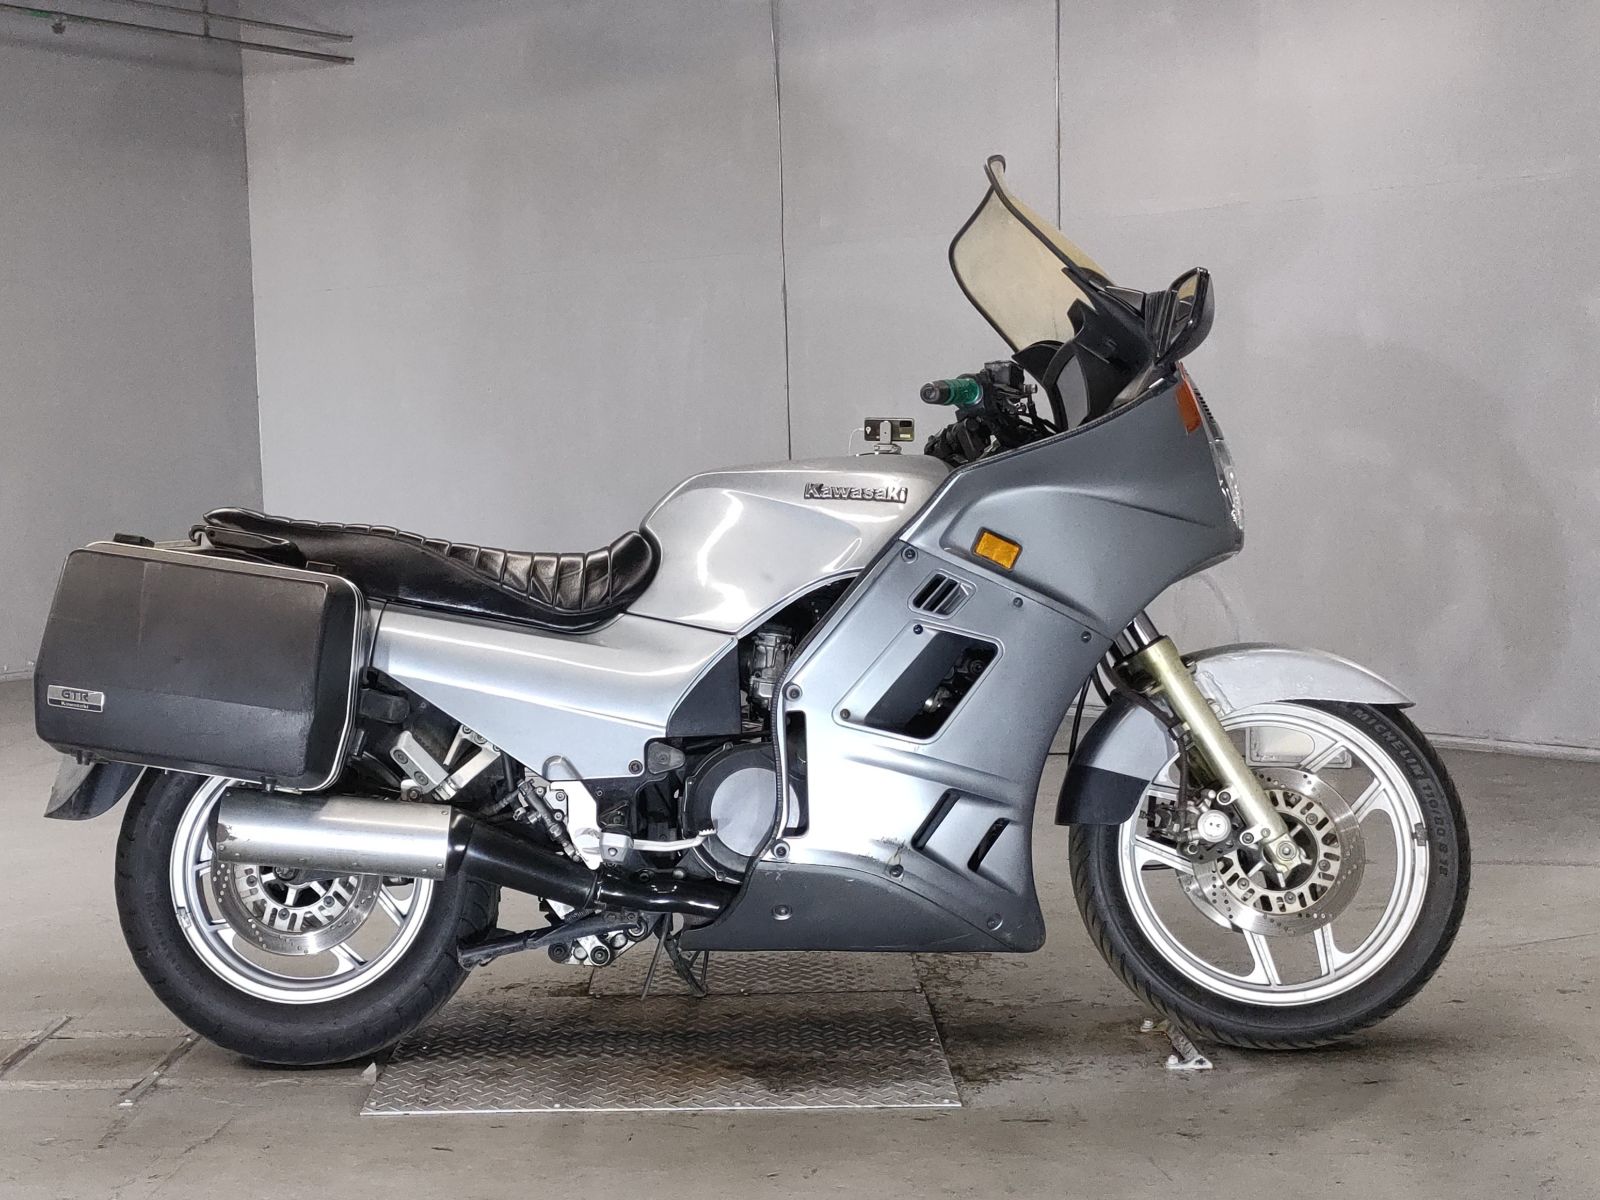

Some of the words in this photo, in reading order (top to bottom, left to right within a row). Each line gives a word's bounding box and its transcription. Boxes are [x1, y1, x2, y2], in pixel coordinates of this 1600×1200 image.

[803, 483, 908, 504] Kawasaki
[61, 689, 89, 702] GTR
[1352, 709, 1425, 778] MICHELIN
